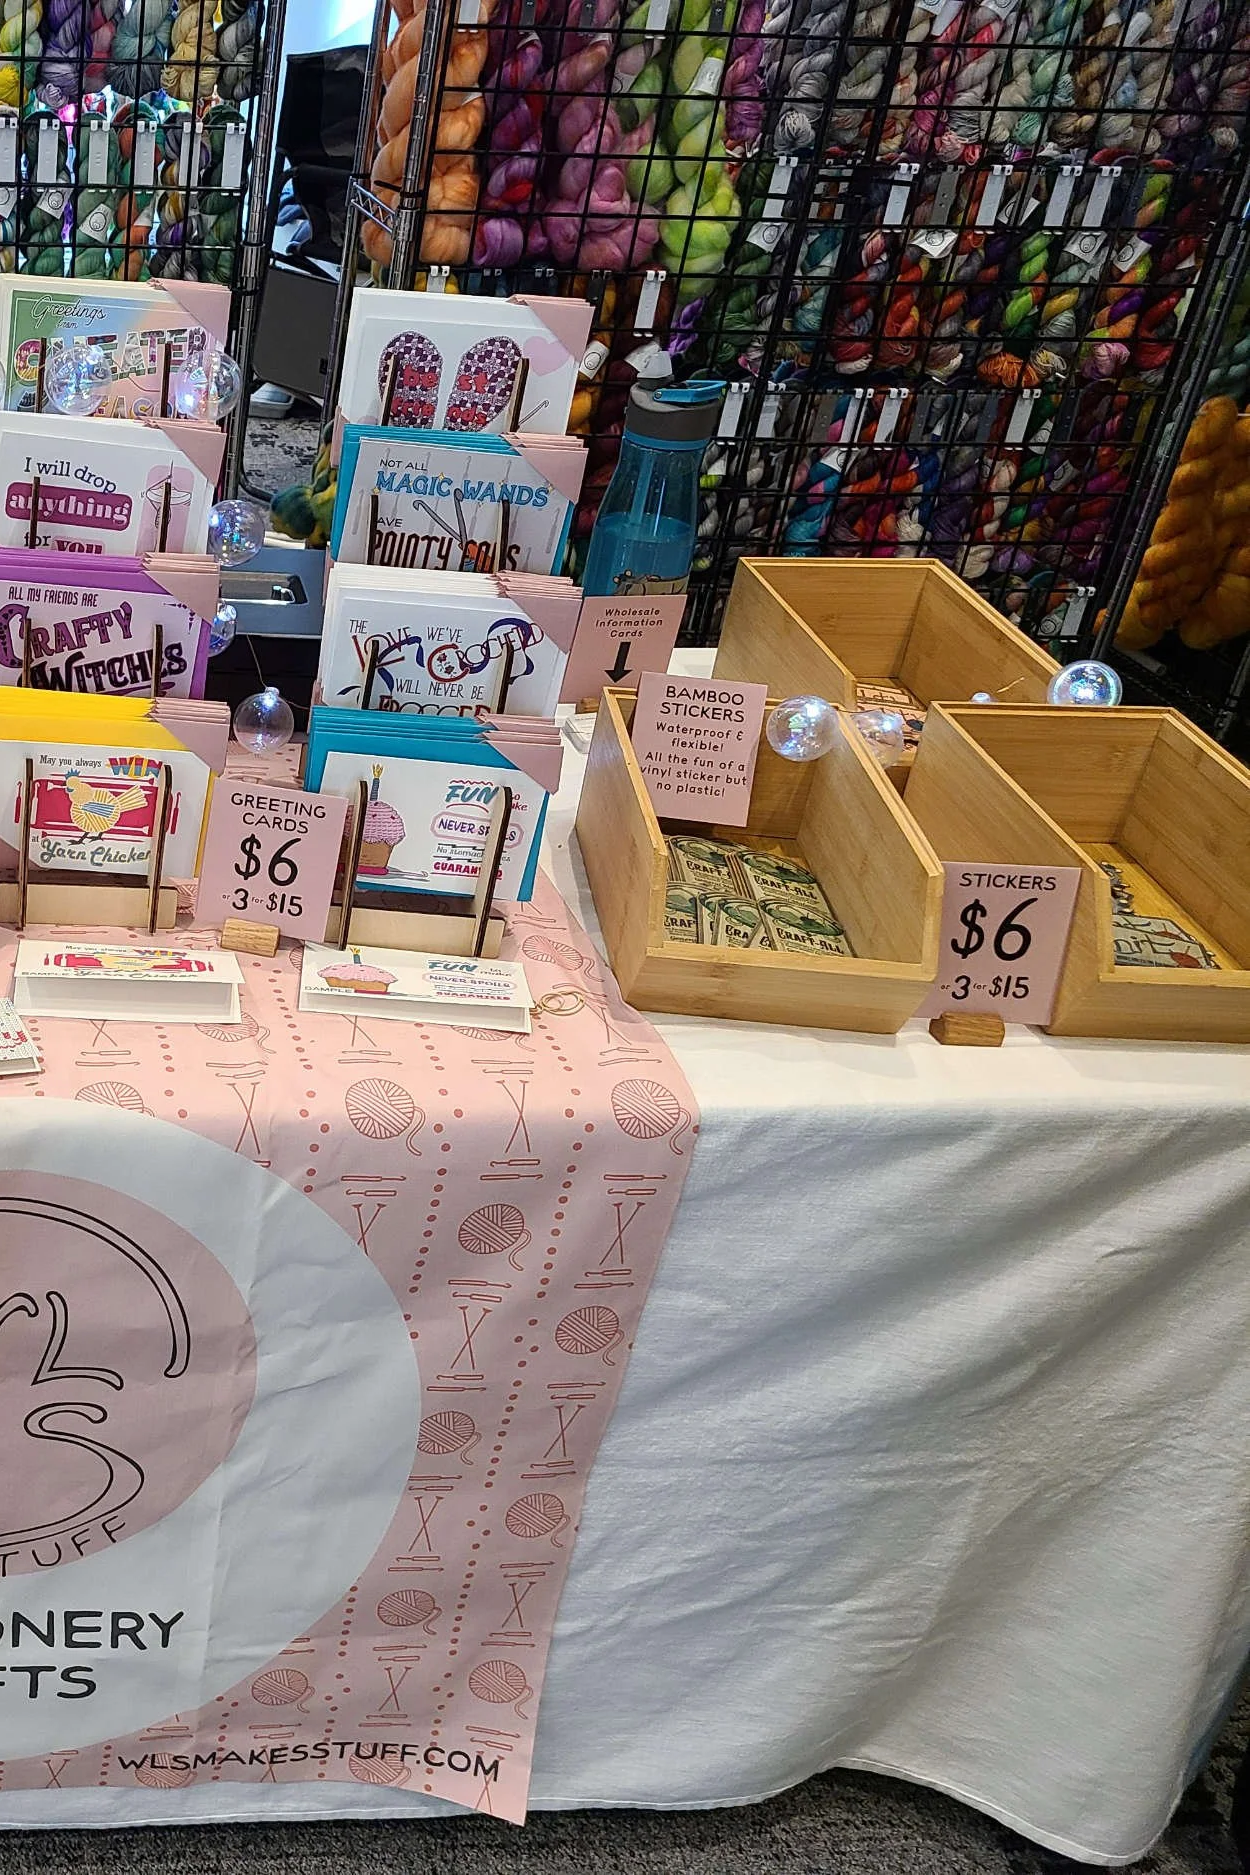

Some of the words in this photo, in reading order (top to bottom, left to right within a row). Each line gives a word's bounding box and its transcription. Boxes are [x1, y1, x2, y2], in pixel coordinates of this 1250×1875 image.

[31, 295, 106, 328] Greetings
[57, 319, 78, 329] from
[14, 327, 208, 384] CEATER
[25, 457, 31, 473] I
[36, 459, 70, 477] will
[74, 464, 117, 495] drop
[380, 459, 403, 469] NOT
[406, 461, 427, 472] ALL
[376, 470, 452, 498] MAGIC
[462, 479, 550, 507] WANDS
[376, 517, 403, 528] AVE
[8, 586, 23, 601] ALL
[27, 588, 41, 602] MY
[43, 589, 78, 605] FRIENDS
[82, 593, 99, 607] ARE
[595, 617, 663, 628] Information
[605, 607, 661, 617] Wholesale
[350, 619, 368, 635] THE
[427, 626, 464, 643] WE'VE
[610, 629, 644, 638] Cards
[18, 642, 188, 692] WITCHS
[396, 678, 421, 694] WILL
[428, 681, 464, 699] NEVER
[471, 685, 484, 700] BE
[666, 685, 745, 706] BAMBOO
[660, 701, 745, 723] STICKERS
[656, 721, 732, 740] Waterproof
[671, 738, 724, 753] flexible!
[40, 755, 56, 766] May
[59, 757, 72, 767] you
[75, 758, 102, 768] always
[107, 754, 163, 779] WIN
[645, 751, 664, 763] All
[667, 752, 688, 765] the
[693, 755, 714, 769] fun
[719, 759, 735, 771] of
[737, 763, 745, 772] a
[640, 765, 672, 778] vinyl
[676, 768, 721, 783] sticker
[725, 773, 747, 786] but
[445, 785, 500, 804] FUN
[656, 782, 672, 791] no
[677, 782, 726, 798] plastic!
[231, 792, 327, 819] GREETING
[242, 813, 309, 834] CARDS
[438, 818, 476, 834] NEVER
[31, 835, 40, 843] at
[436, 845, 447, 854] No
[40, 838, 87, 864] Yarn
[234, 833, 302, 887] $6
[959, 873, 1057, 891] STICKERS
[222, 893, 230, 901] or
[231, 888, 248, 912] 3
[251, 896, 264, 905] for
[265, 890, 303, 917] $15
[950, 897, 1038, 962] $6
[428, 961, 479, 972] FUN
[304, 985, 353, 993] SAMPLE
[430, 975, 467, 984] NEVER
[941, 982, 950, 990] or
[951, 974, 969, 1000] 3
[973, 982, 987, 990] for
[989, 975, 1029, 1000] $15
[117, 1741, 501, 1782] WLSMAKESSTUFF.COM
